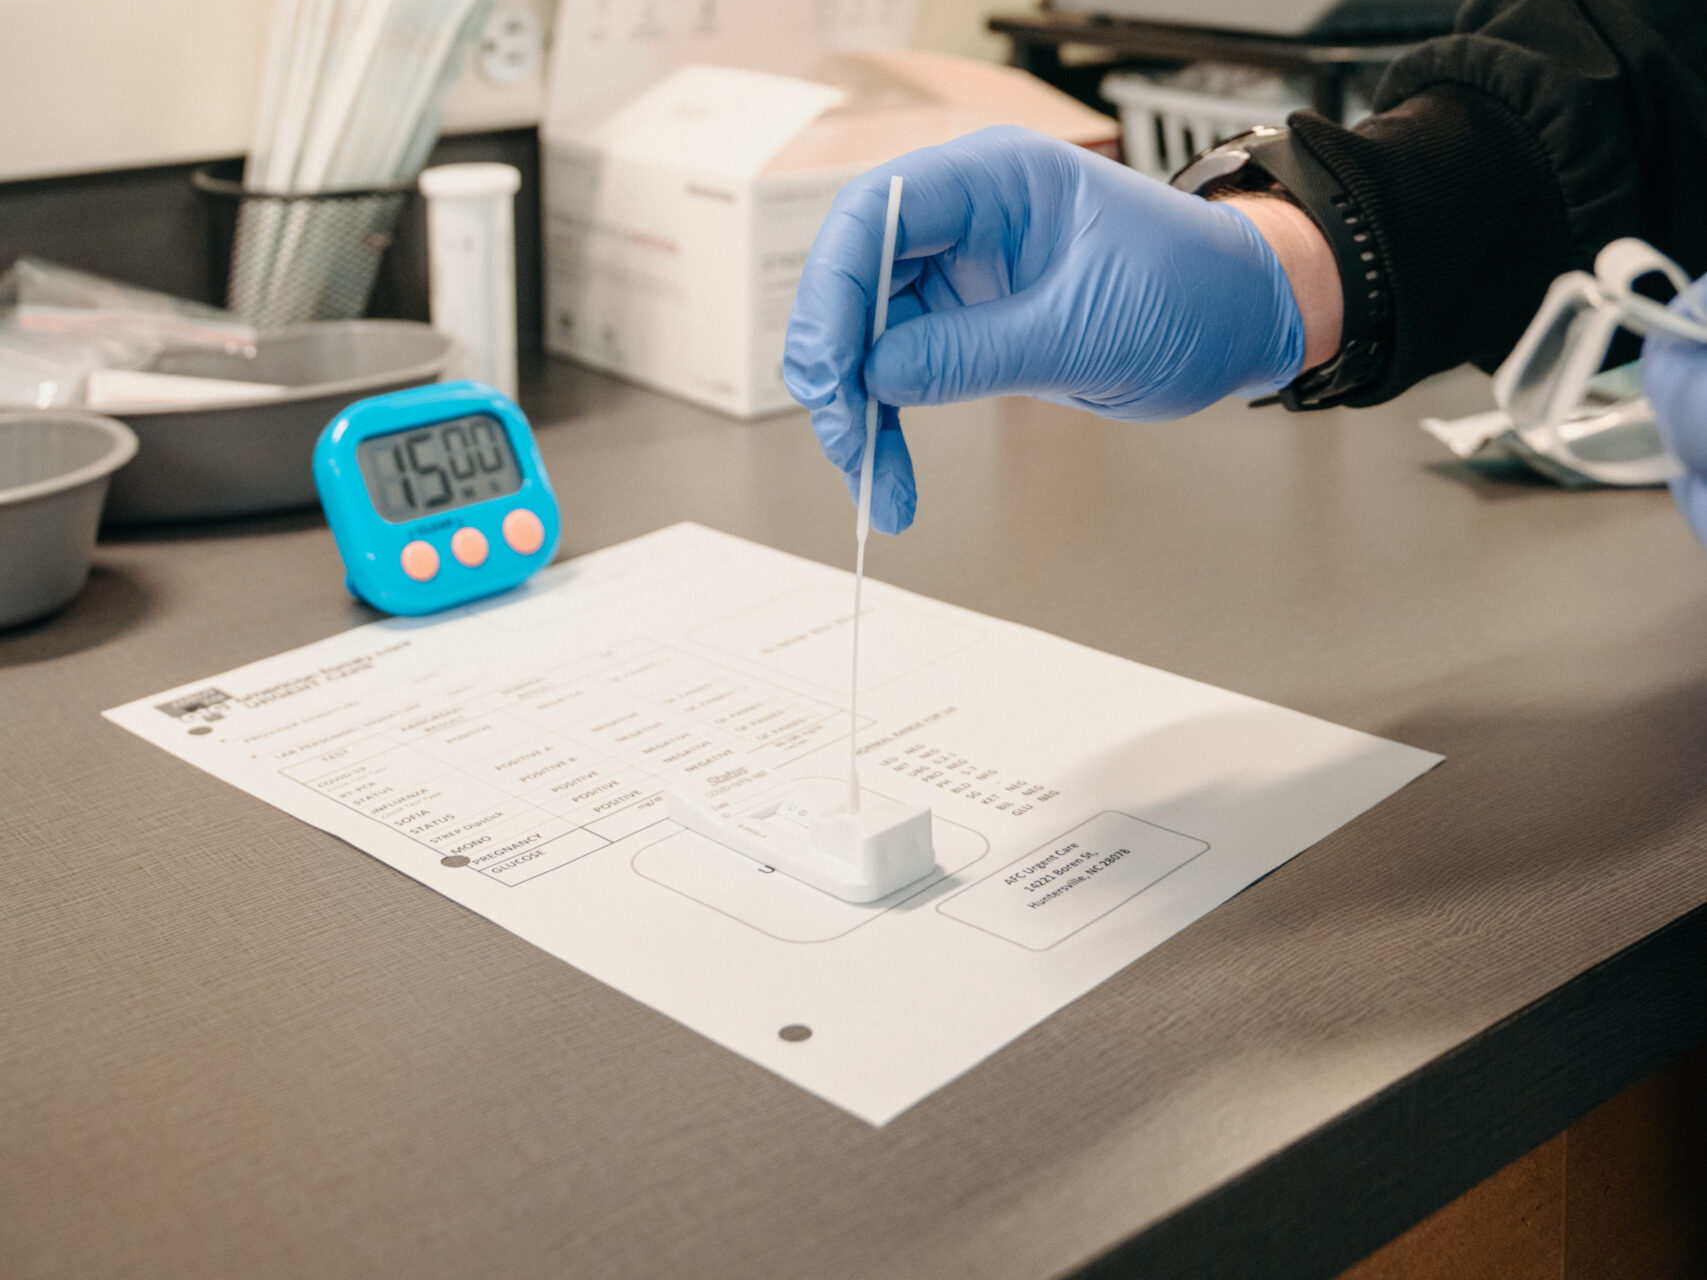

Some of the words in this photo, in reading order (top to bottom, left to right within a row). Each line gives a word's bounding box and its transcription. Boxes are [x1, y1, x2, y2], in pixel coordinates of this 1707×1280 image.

[519, 761, 566, 782] POSITIVE
[684, 749, 733, 772] NEGATIVE
[551, 771, 598, 792] POSITIVE
[706, 767, 748, 787] Status
[950, 783, 971, 794] BLD
[976, 770, 998, 781] NEG
[353, 787, 393, 805] STATUS
[371, 789, 428, 814] INFLUENZA
[571, 780, 619, 803] POSITIVE
[593, 790, 640, 813] POSITIVE
[965, 791, 982, 799] SG
[981, 794, 999, 804] KET
[1005, 781, 1027, 791] NEG
[995, 802, 1014, 810] BIL
[1022, 786, 1044, 796] NEG
[1012, 804, 1033, 816] GLU
[1037, 791, 1060, 801] NEG
[394, 810, 430, 826] SOFIA
[409, 814, 455, 834] STATUS
[429, 829, 461, 844] STREP
[450, 836, 491, 854] MONO
[470, 833, 541, 865] PREGNANCY
[491, 850, 545, 873] GLUCOSE
[1004, 872, 1026, 885] AFC
[1022, 855, 1059, 874] Urgent
[1055, 843, 1079, 856] Care
[1024, 874, 1056, 892] 14221
[1053, 859, 1084, 875] Boren
[1028, 876, 1092, 909] Huntersville,
[1085, 865, 1104, 875] NC
[1099, 849, 1131, 866] 28078
